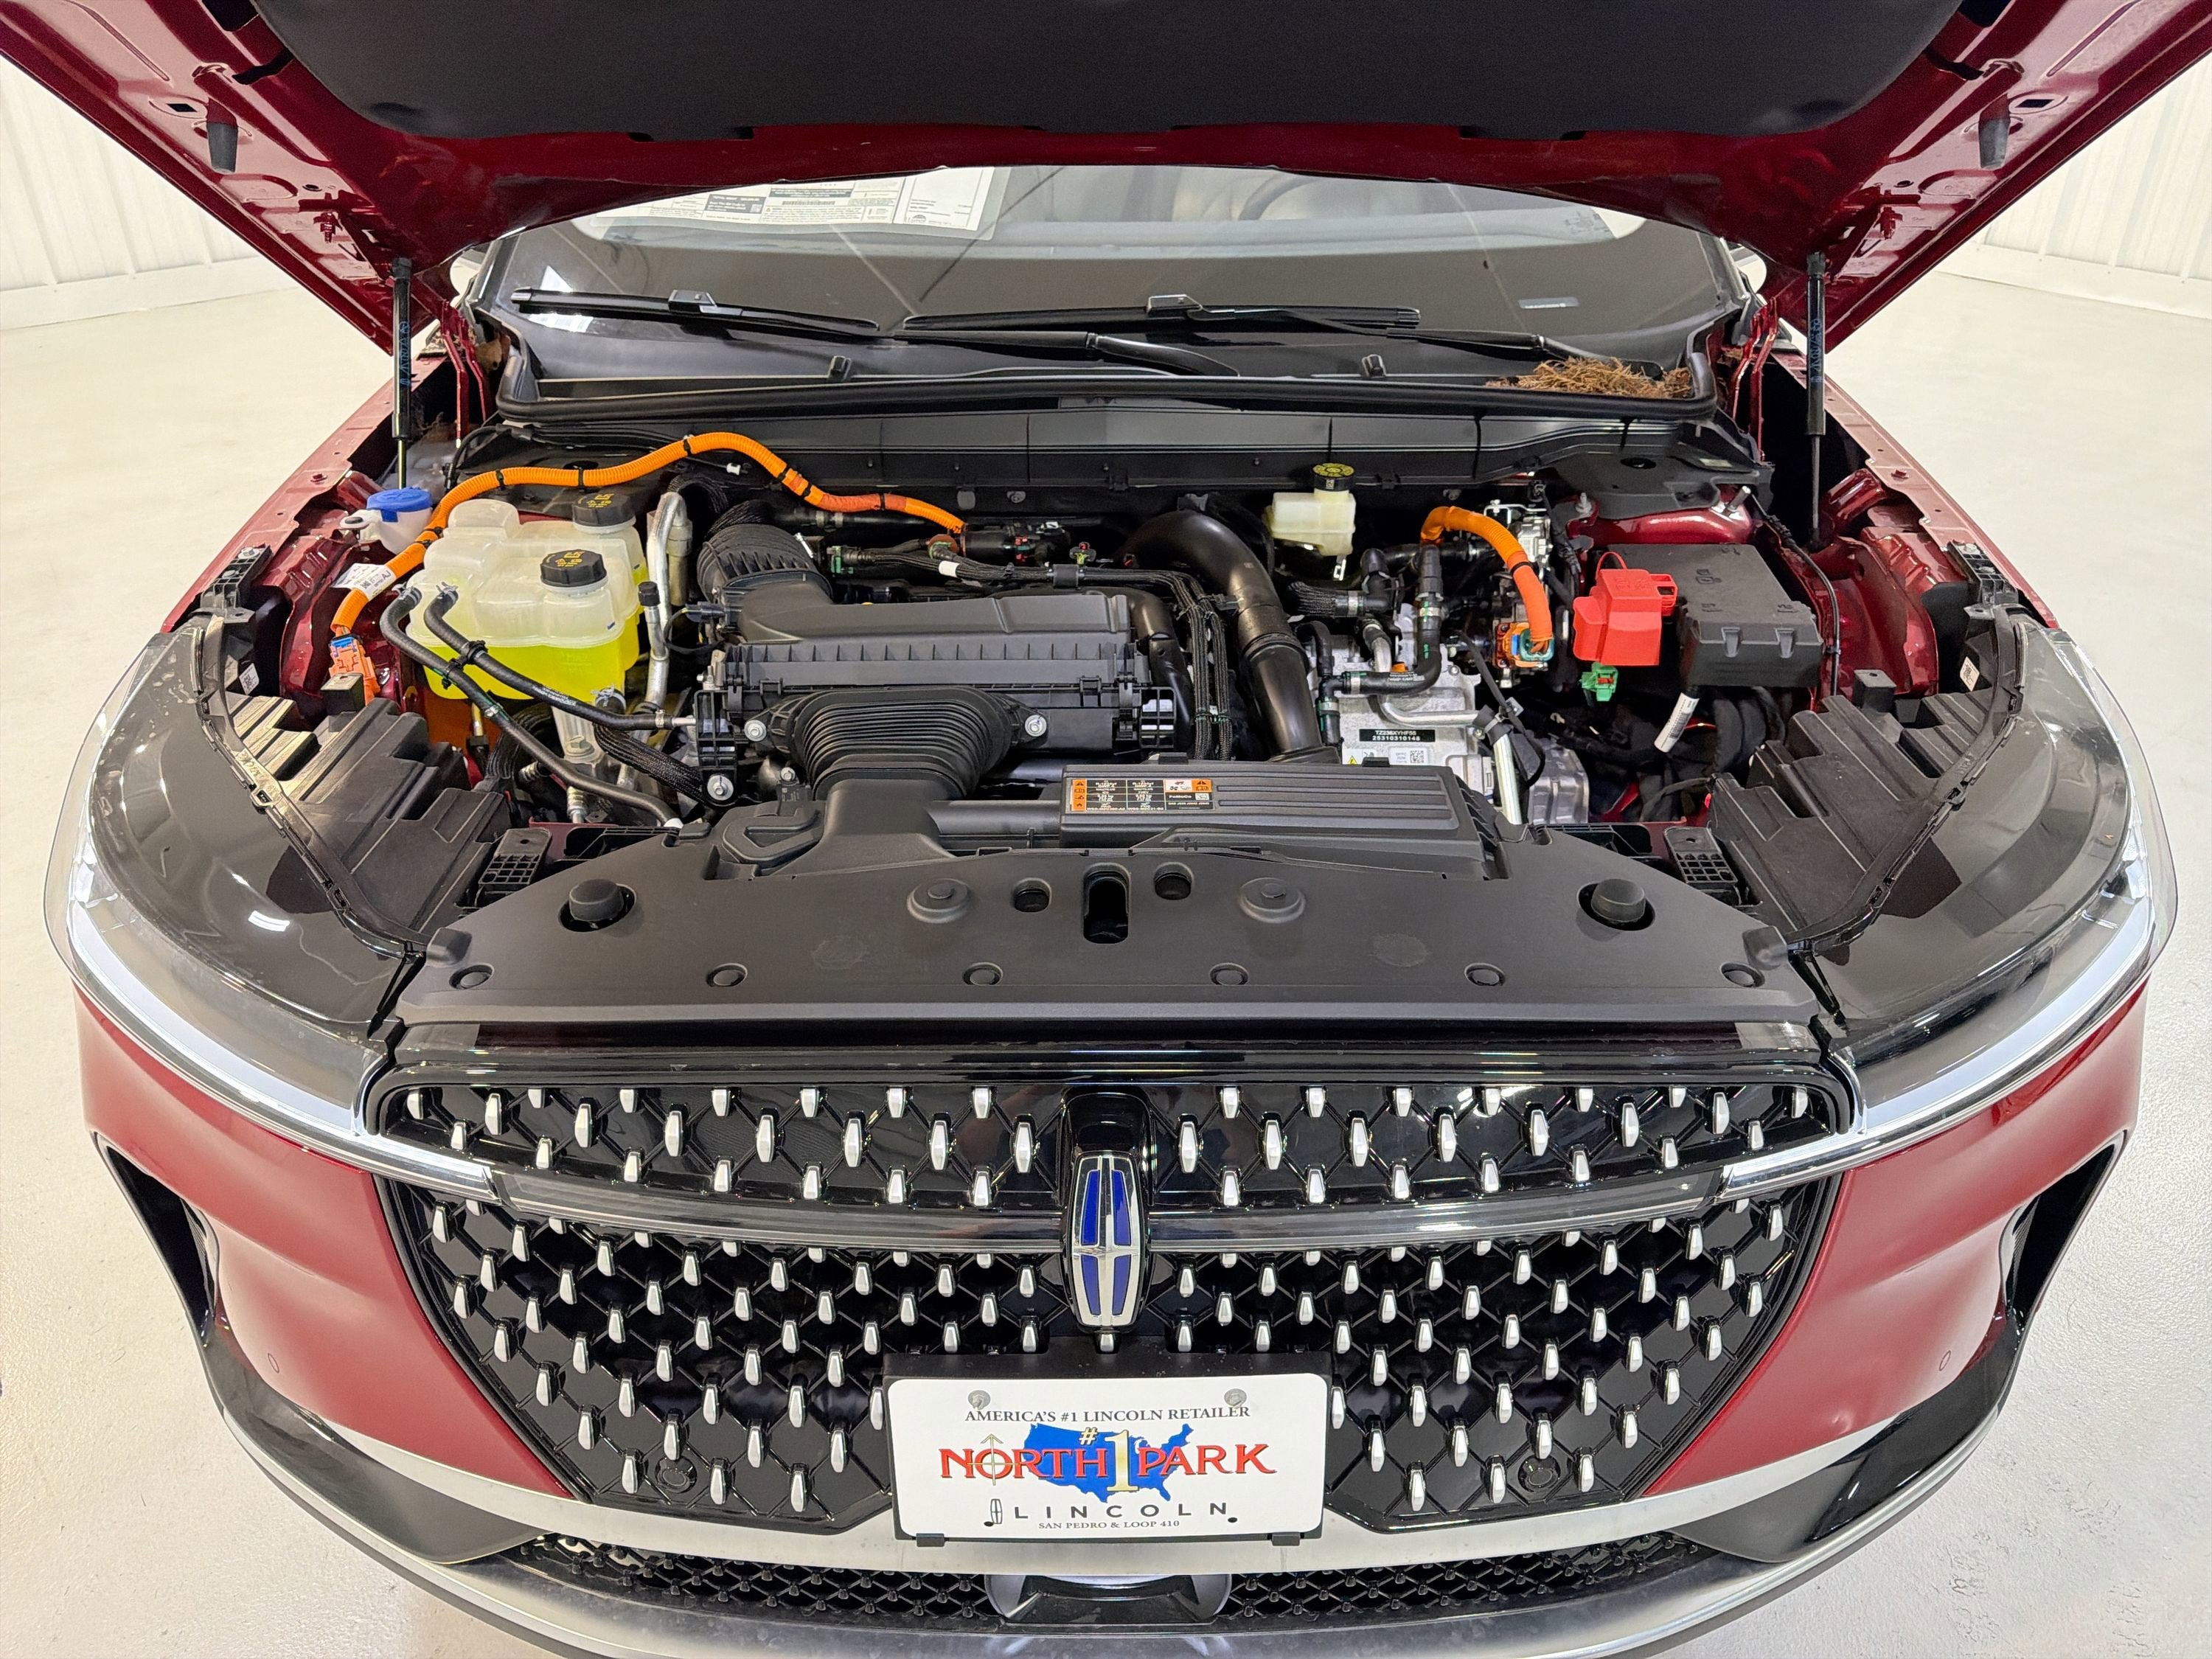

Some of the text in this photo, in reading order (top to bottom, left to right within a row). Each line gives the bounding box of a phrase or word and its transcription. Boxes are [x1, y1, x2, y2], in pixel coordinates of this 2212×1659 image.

[964, 1406, 1251, 1422] AMERICA'S #1 LINCOLN RETAILER
[938, 1443, 1278, 1480] NORTH PARK
[1015, 1502, 1227, 1519] LINCOLN
[1063, 1521, 1107, 1529] PEDRO
